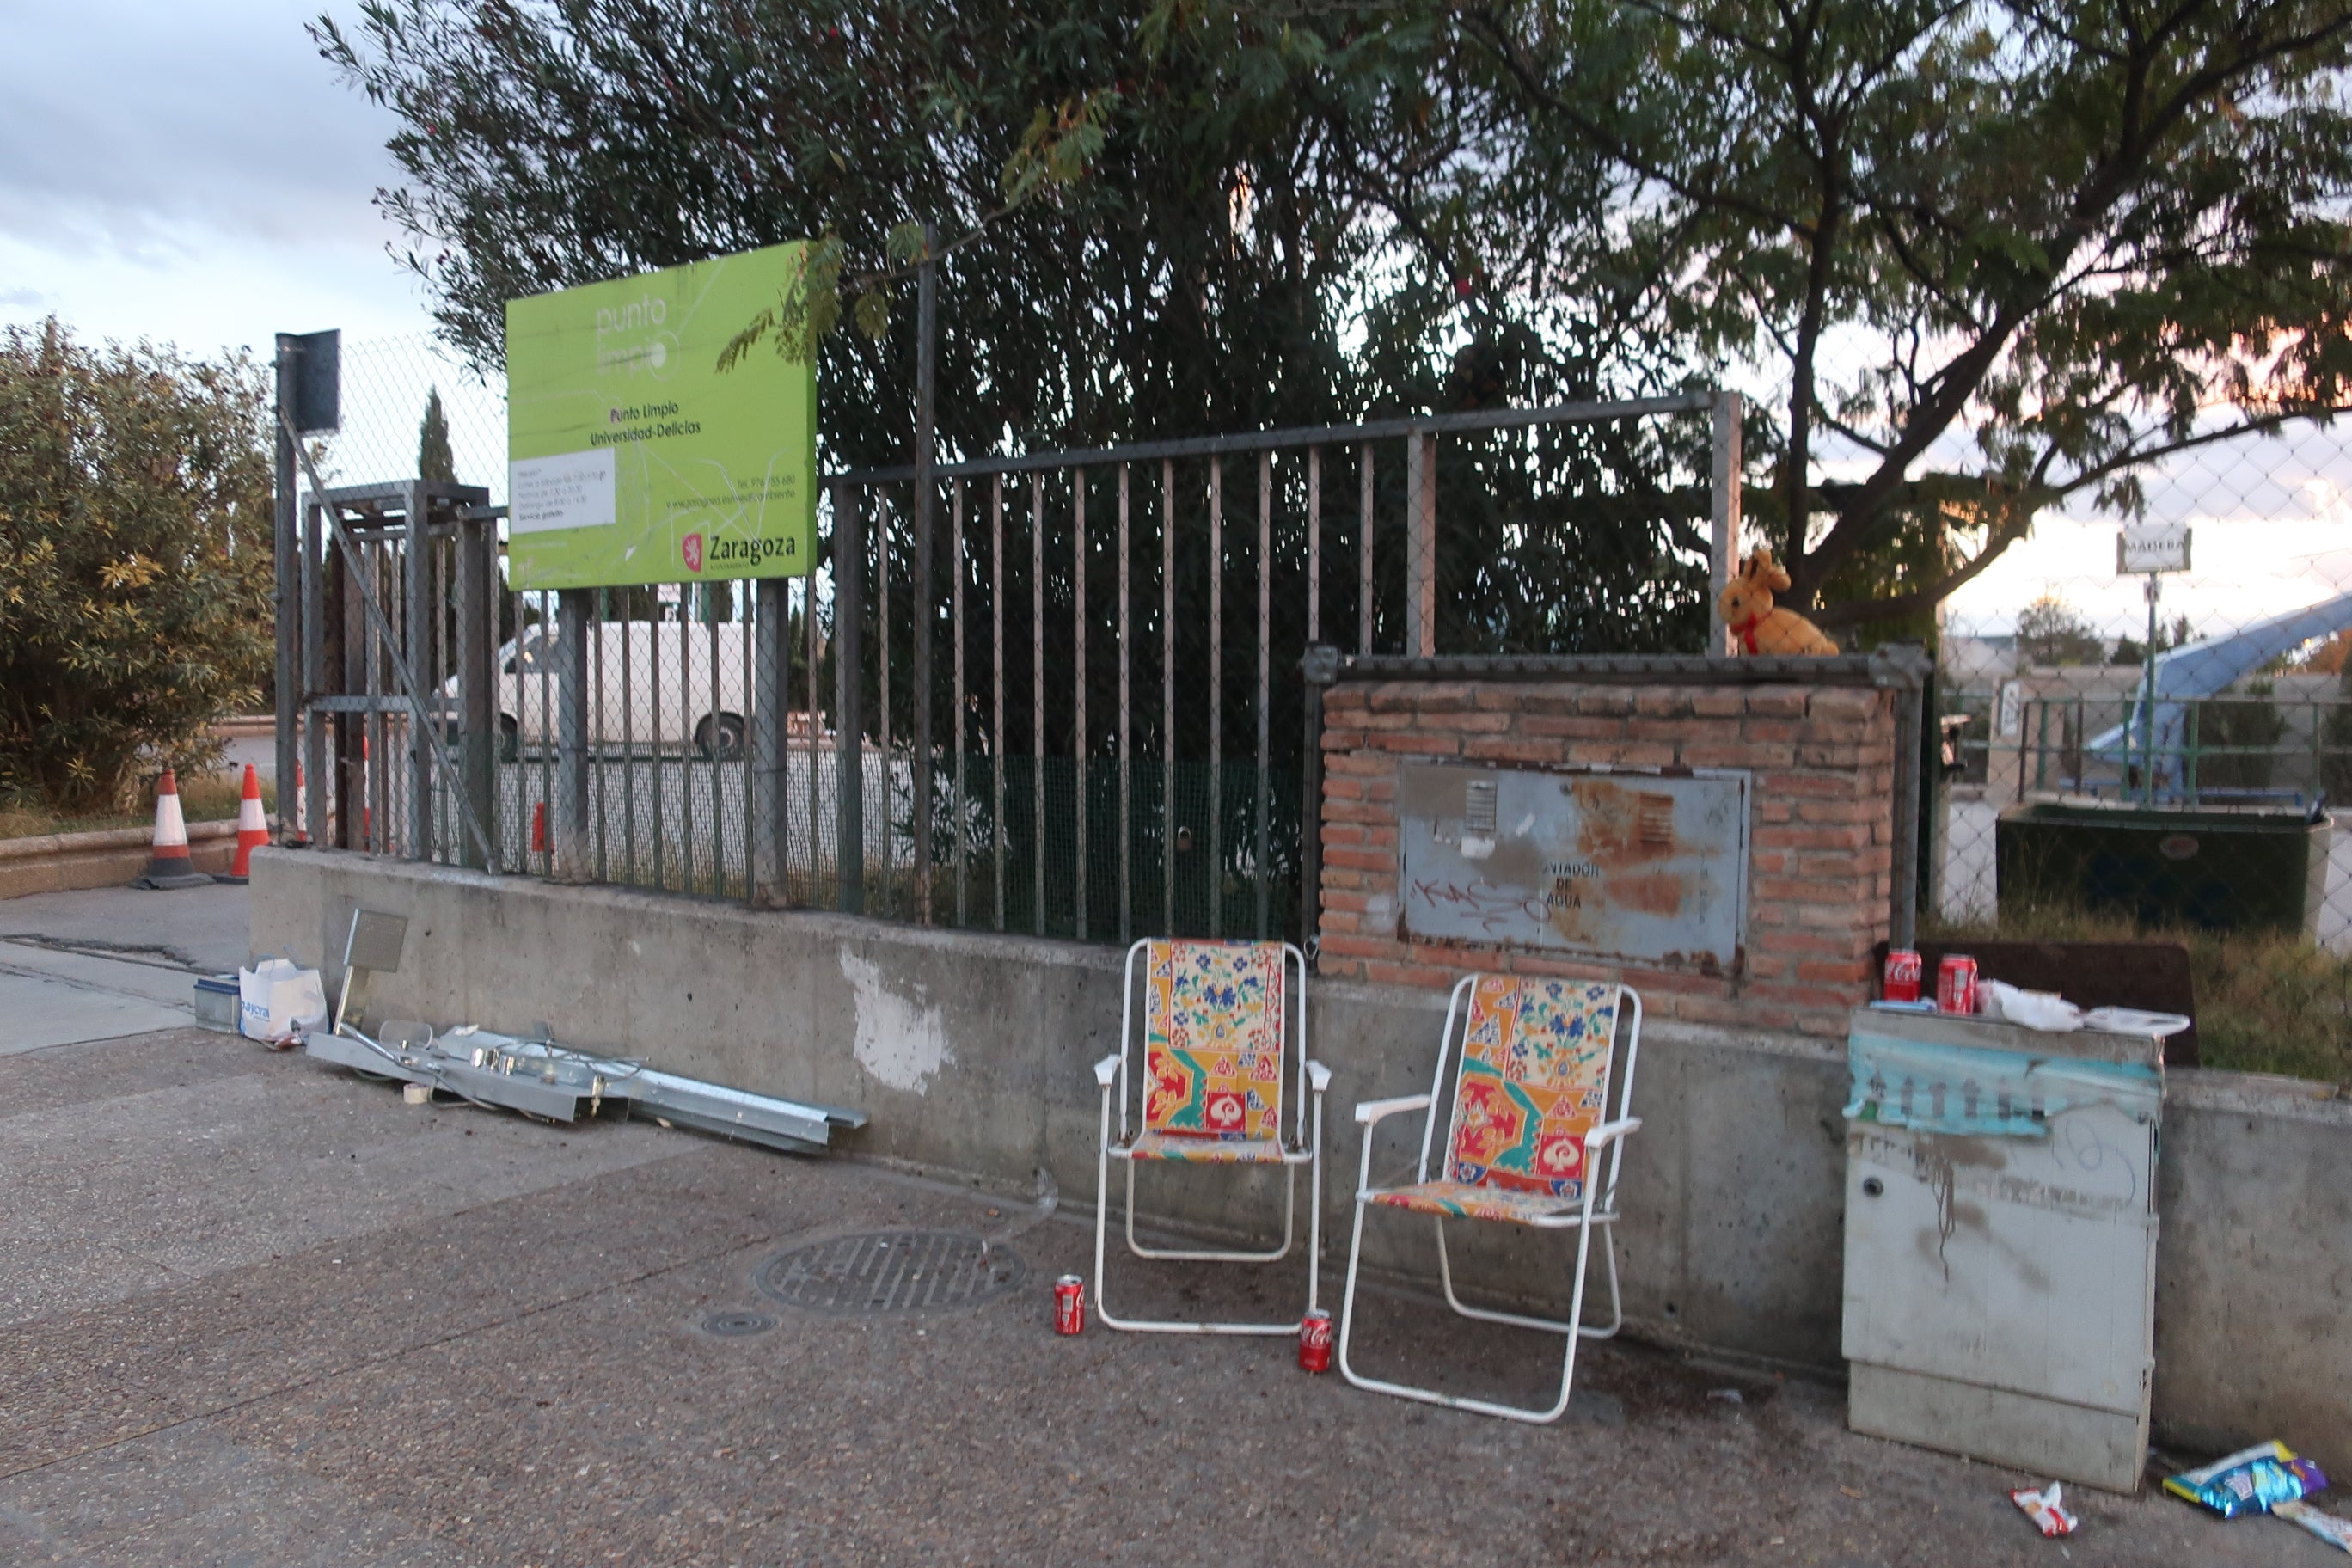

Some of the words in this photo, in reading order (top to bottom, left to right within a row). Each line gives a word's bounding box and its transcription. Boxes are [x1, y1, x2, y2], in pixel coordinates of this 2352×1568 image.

[597, 293, 666, 334] punto
[610, 407, 640, 424] Punto
[643, 400, 679, 420] Limpio
[591, 420, 701, 446] Universidad-Delicias
[709, 536, 796, 567] Zaragoza
[1556, 877, 1573, 891] DE
[1546, 891, 1582, 909] AGUA
